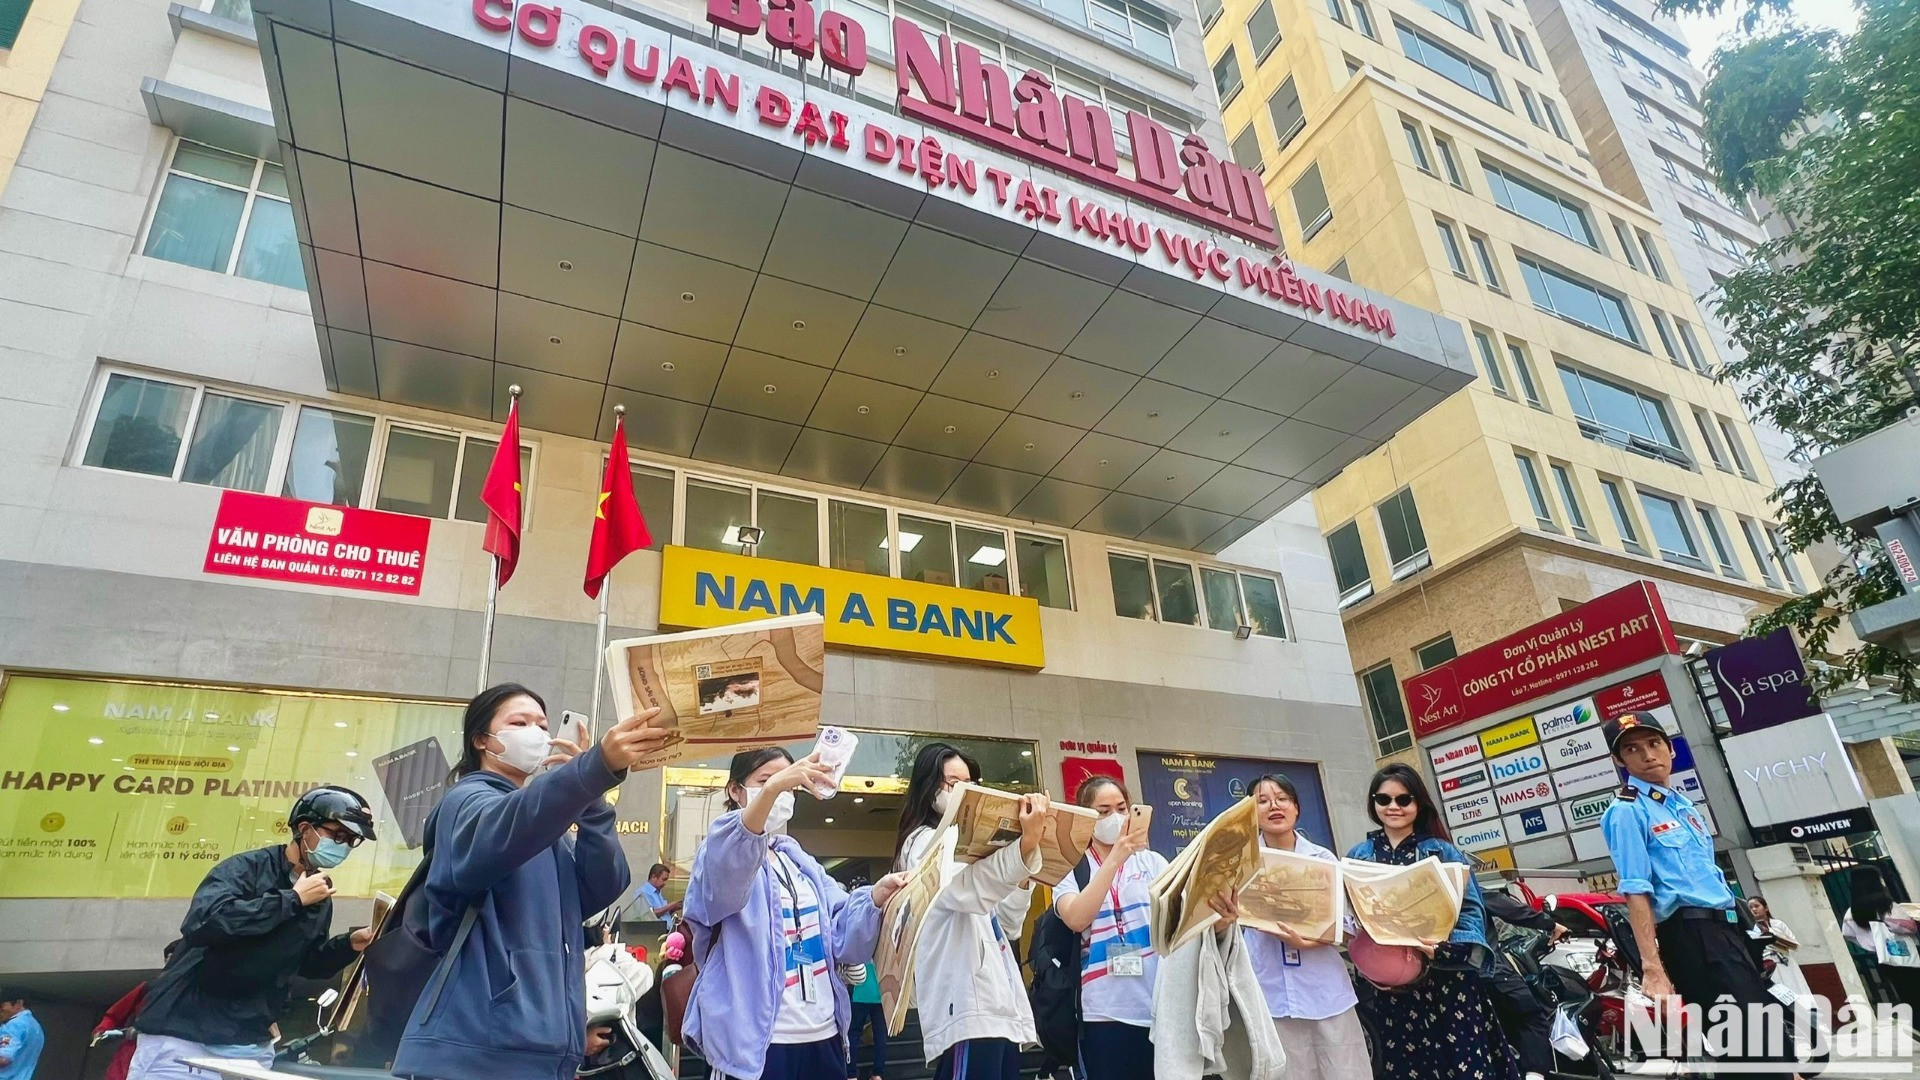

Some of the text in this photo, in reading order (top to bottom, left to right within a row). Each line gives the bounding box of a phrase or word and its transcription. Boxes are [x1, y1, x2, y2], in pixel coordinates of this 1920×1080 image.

[893, 16, 1118, 173] Nhân
[1125, 110, 1275, 233] Dân
[473, 0, 1397, 338] CƠ QUAN ĐẠI DIỆN TẠI KHU VỰC MIỀN NAM
[217, 527, 421, 568] VĂN PHÒNG CHO THUÊ
[213, 552, 415, 586] LIÊN HỆ BAN QUẢN LÝ: 0971 12 82 82
[695, 571, 1017, 645] NAM A BANK
[1503, 618, 1583, 660] Đơn Vị Quản Lý
[1463, 614, 1650, 697] CÔNG TY CỔ PHẦN NEST ART
[1529, 677, 1553, 690] Hotline
[1555, 669, 1572, 681] 0971
[1573, 664, 1586, 675] 128
[1586, 659, 1599, 671] 282
[1757, 668, 1800, 694] spa
[104, 702, 278, 728] NAM A BANK
[1419, 703, 1459, 726] Nest Art
[1541, 714, 1573, 736] palma
[1486, 738, 1503, 747] NAM
[1509, 728, 1531, 740] BANK
[151, 757, 166, 767] TÍN
[1445, 747, 1464, 761] Nhân
[1463, 744, 1479, 756] Dân
[1161, 758, 1216, 769] NAM A BANK
[1491, 756, 1541, 780] hoiio
[1743, 751, 1827, 784] VICHY
[1, 770, 106, 793] HAPPY
[113, 774, 194, 796] CARD
[403, 782, 442, 801] Happy Card
[1182, 800, 1203, 808] banking
[1499, 788, 1536, 806] MIMS
[1574, 800, 1610, 818] KBVN
[615, 820, 649, 835] HẠCH
[1525, 816, 1544, 829] ATS
[1804, 819, 1851, 835] THAIYEN
[1172, 827, 1200, 839] mọi trả
[1456, 828, 1501, 846] Cominix
[67, 839, 97, 848] 100%
[64, 850, 94, 860] dụng
[163, 852, 175, 860] 01
[179, 851, 190, 861] tỷ
[192, 851, 220, 861] đồng
